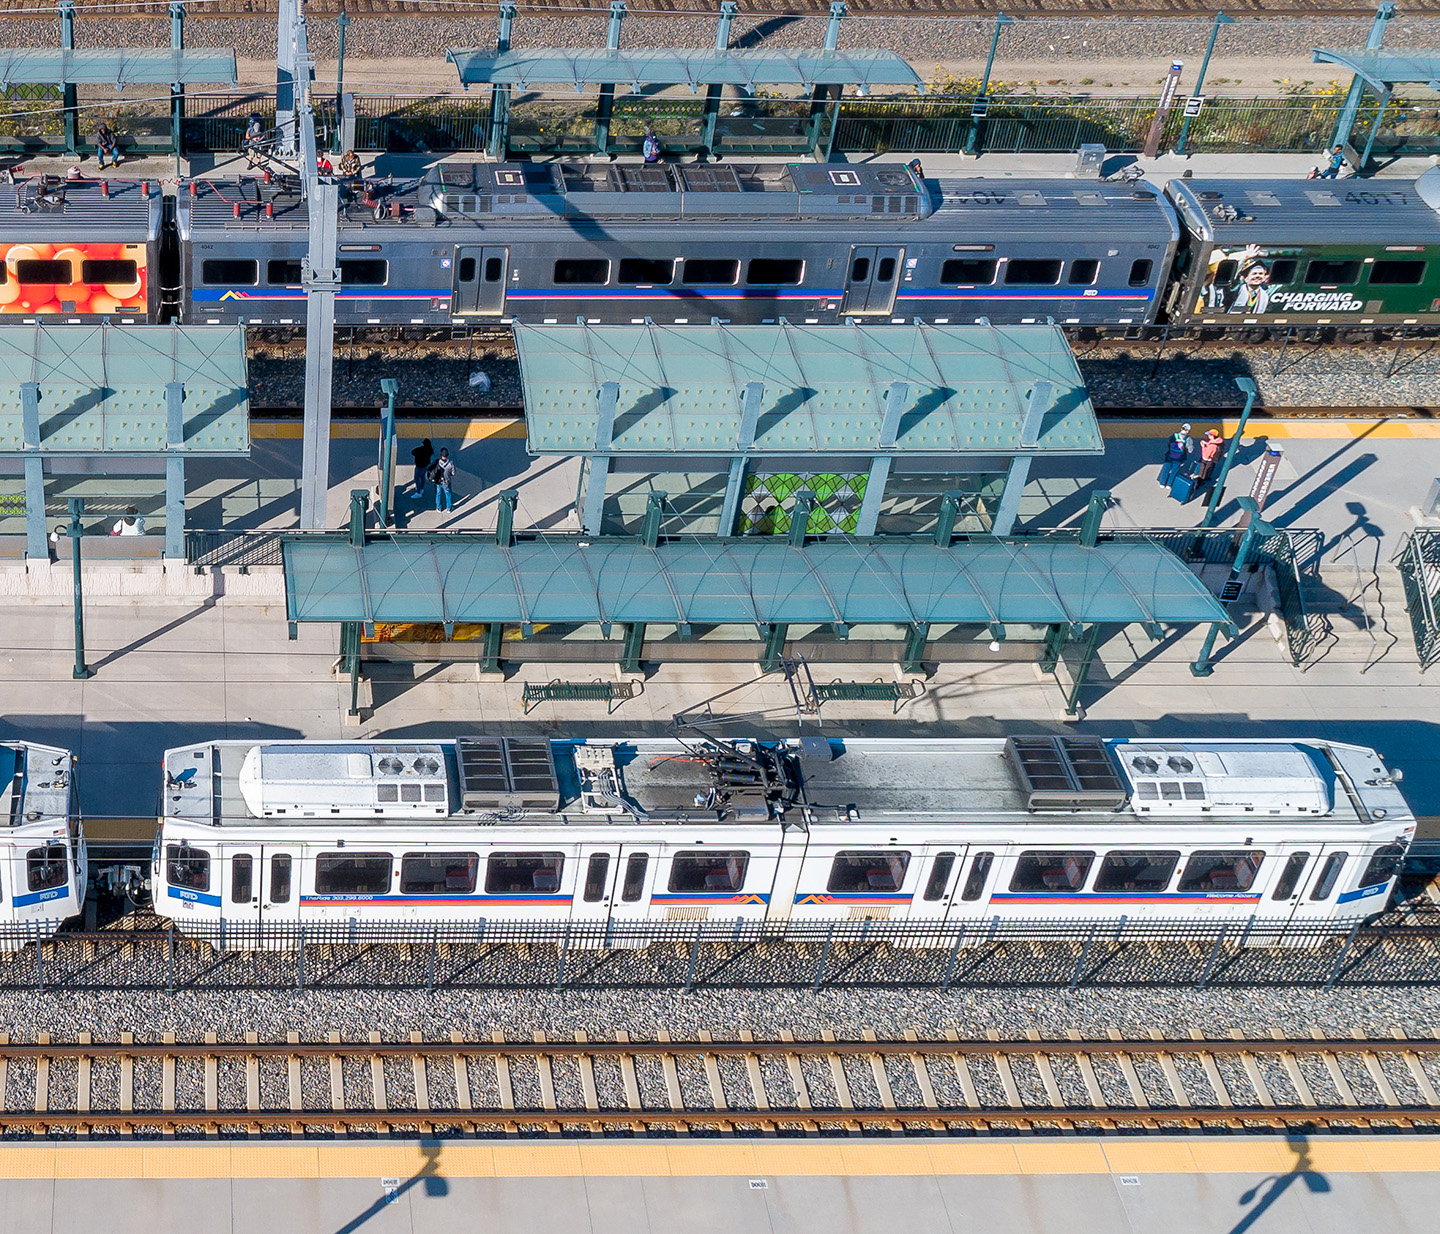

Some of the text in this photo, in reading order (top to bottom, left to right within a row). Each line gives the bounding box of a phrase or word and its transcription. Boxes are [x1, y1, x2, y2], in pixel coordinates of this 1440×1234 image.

[1345, 192, 1407, 205] 4017
[1270, 292, 1353, 303] CHARGING
[1282, 300, 1363, 311] FORWARD
[39, 890, 59, 900] RTD
[179, 890, 199, 901] RTD
